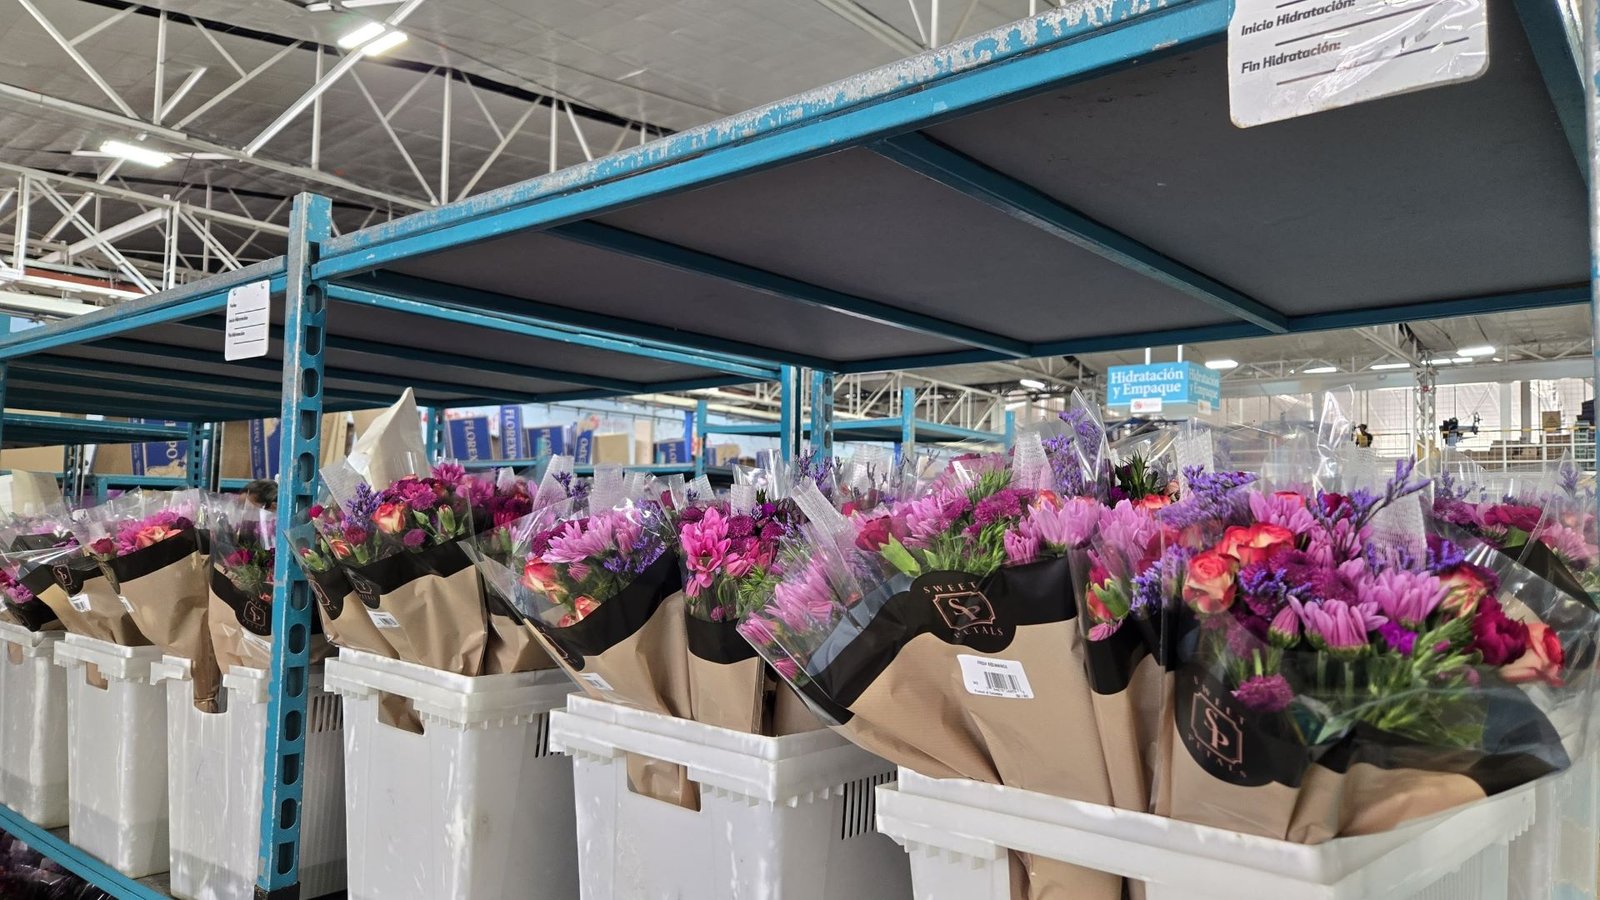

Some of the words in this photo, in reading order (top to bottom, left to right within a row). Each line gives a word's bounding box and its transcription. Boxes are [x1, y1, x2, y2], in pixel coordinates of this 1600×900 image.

[1241, 19, 1274, 36] Inicio
[1276, 0, 1356, 26] Hidratación:
[1241, 60, 1260, 74] Fin
[1263, 41, 1342, 69] Hidratación:
[1111, 367, 1183, 384] Hidratación
[1113, 386, 1120, 398] y
[1122, 383, 1181, 397] Empaque
[923, 582, 977, 594] SWEET
